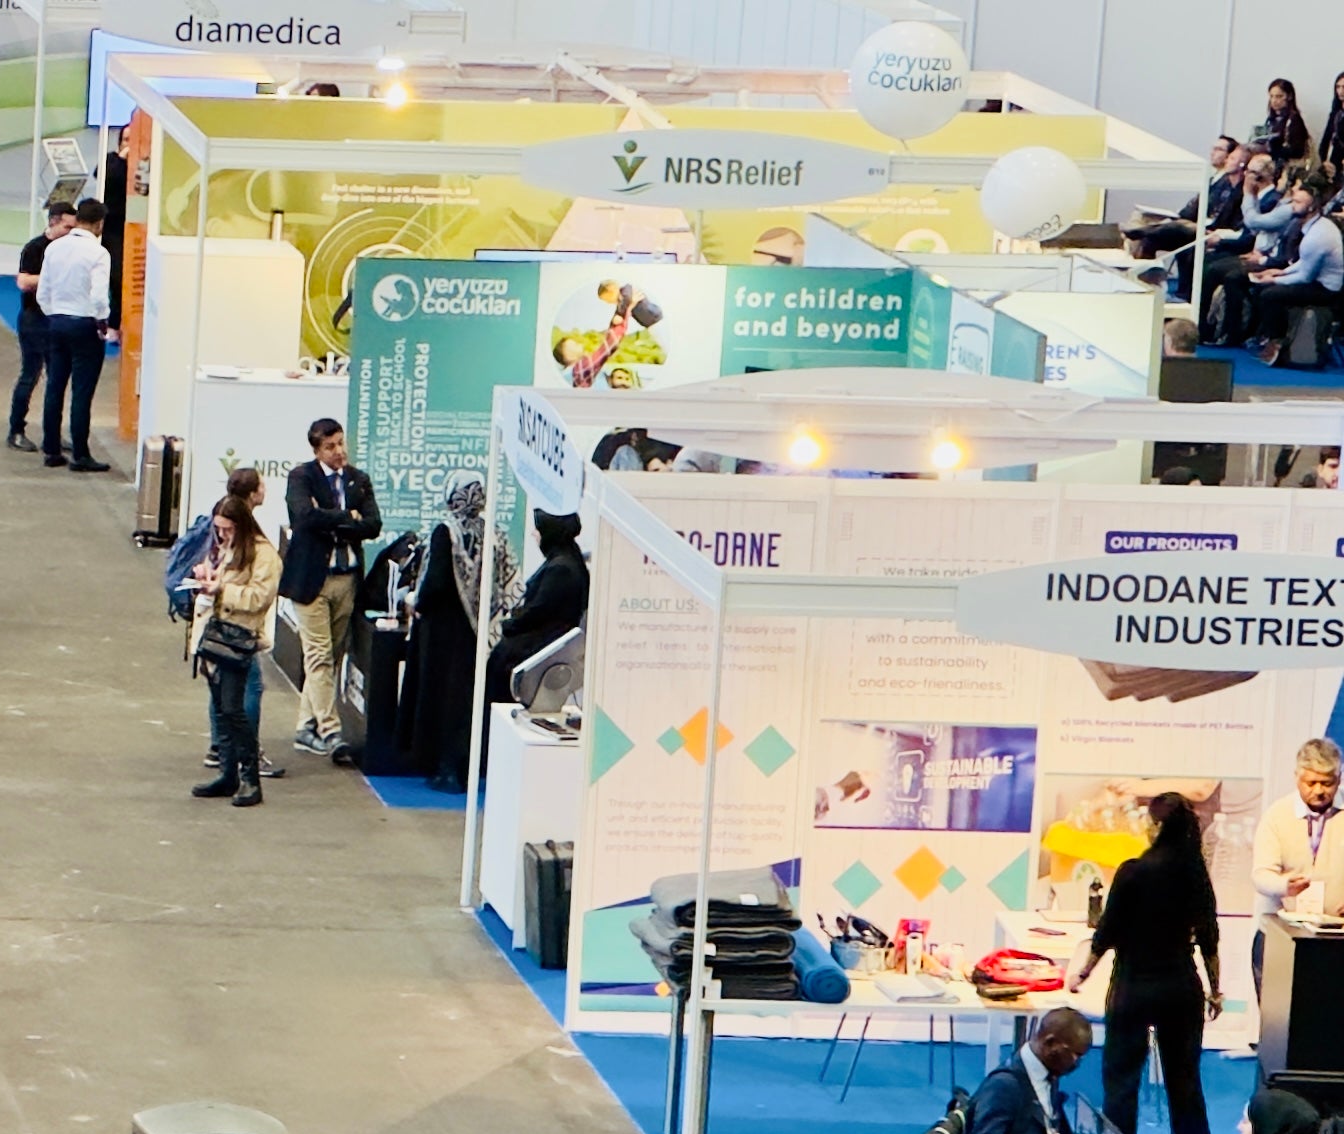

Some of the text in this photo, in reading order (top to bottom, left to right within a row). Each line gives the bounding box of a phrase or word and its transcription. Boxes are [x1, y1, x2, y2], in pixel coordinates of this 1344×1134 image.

[175, 15, 341, 46] diamedica
[734, 286, 902, 311] for children
[733, 316, 900, 343] and beyond
[393, 338, 406, 390] SCHOOL
[356, 359, 372, 459] INTERVENTION
[411, 343, 430, 451] PROTECTION
[374, 356, 393, 490] LEGAL SUPPORT
[389, 453, 489, 468] EDUCATION
[1110, 535, 1233, 551] OUR PRODUCTS
[1046, 573, 1250, 605] INDODANE
[618, 598, 671, 611] ABOUT
[866, 633, 1004, 646] with a commitm
[1115, 614, 1344, 648] INDUSTRIES
[722, 643, 796, 654] nternational
[878, 655, 989, 671] to sustainability
[858, 677, 886, 689] and
[924, 755, 1014, 776] SUSTAINABLE
